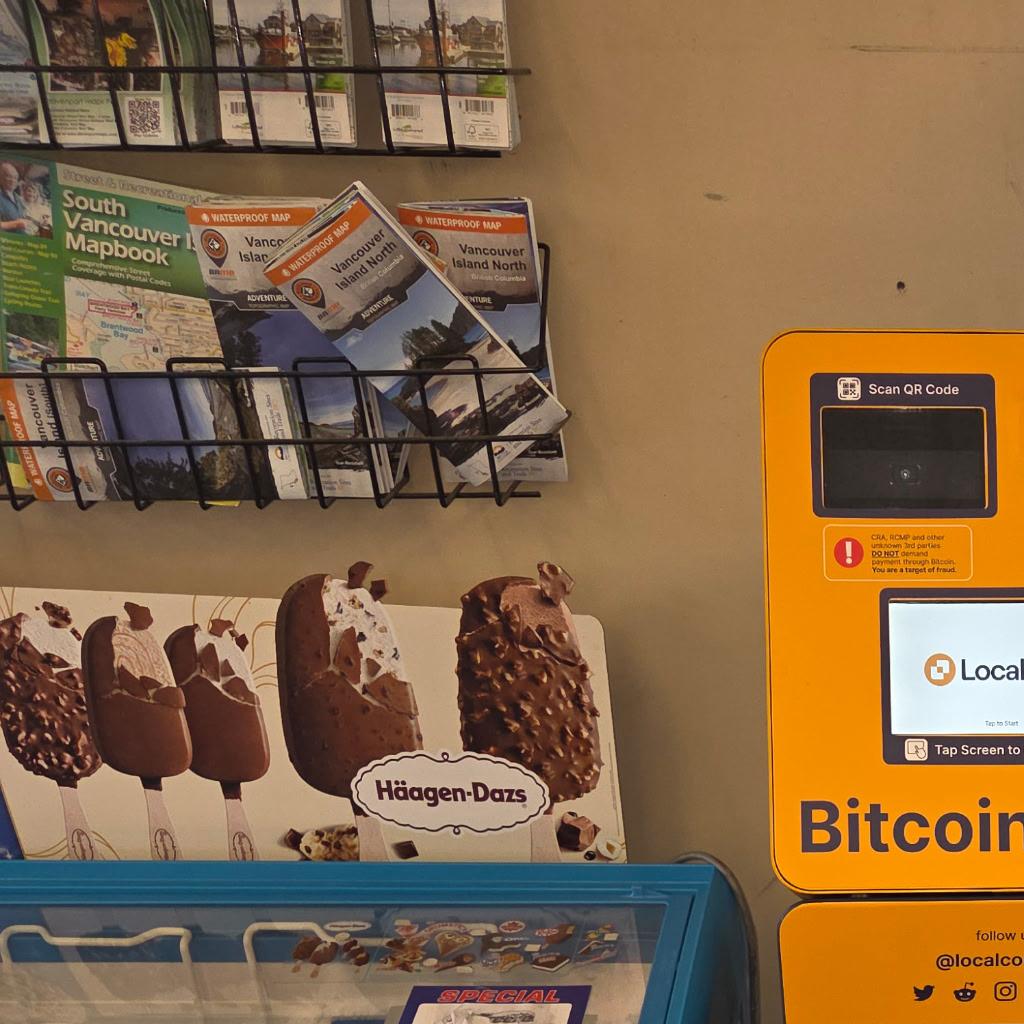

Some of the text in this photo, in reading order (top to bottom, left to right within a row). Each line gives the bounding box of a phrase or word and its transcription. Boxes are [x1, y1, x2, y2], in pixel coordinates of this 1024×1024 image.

[62, 189, 127, 218] South
[211, 212, 292, 223] WATERPROOF MAP
[425, 216, 502, 231] WATERPROOF MAP
[63, 209, 182, 248] Vancouver
[65, 231, 170, 267] Mapbook
[288, 220, 351, 273] WATERPROOF MAP
[330, 228, 385, 275] Vancouver
[458, 243, 525, 258] Vancouver
[71, 257, 129, 273] Comprehensive
[71, 264, 107, 278] Coverage
[108, 269, 124, 280] with
[335, 241, 398, 292] Island North
[377, 254, 405, 278] Columbia
[452, 258, 528, 272] Island North
[494, 274, 528, 283] Columbia
[360, 294, 394, 320] ADVENTURE
[100, 320, 144, 335] Brentwood
[113, 330, 129, 342] Bay
[868, 383, 960, 396] Scan QR Code
[6, 400, 20, 421] MAP
[26, 383, 48, 442] ancouver
[871, 534, 888, 542] CRA,
[889, 534, 911, 542] RCMP
[917, 542, 941, 550] parties
[871, 558, 956, 567] payment through Bitcoin.
[985, 720, 996, 728] Tap
[935, 744, 958, 758] Tap
[961, 744, 1005, 756] Screen
[1008, 745, 1021, 755] to
[375, 779, 527, 808] Häagen-Dazs
[976, 930, 1017, 941] follow
[437, 989, 560, 1004] SPECIAL
